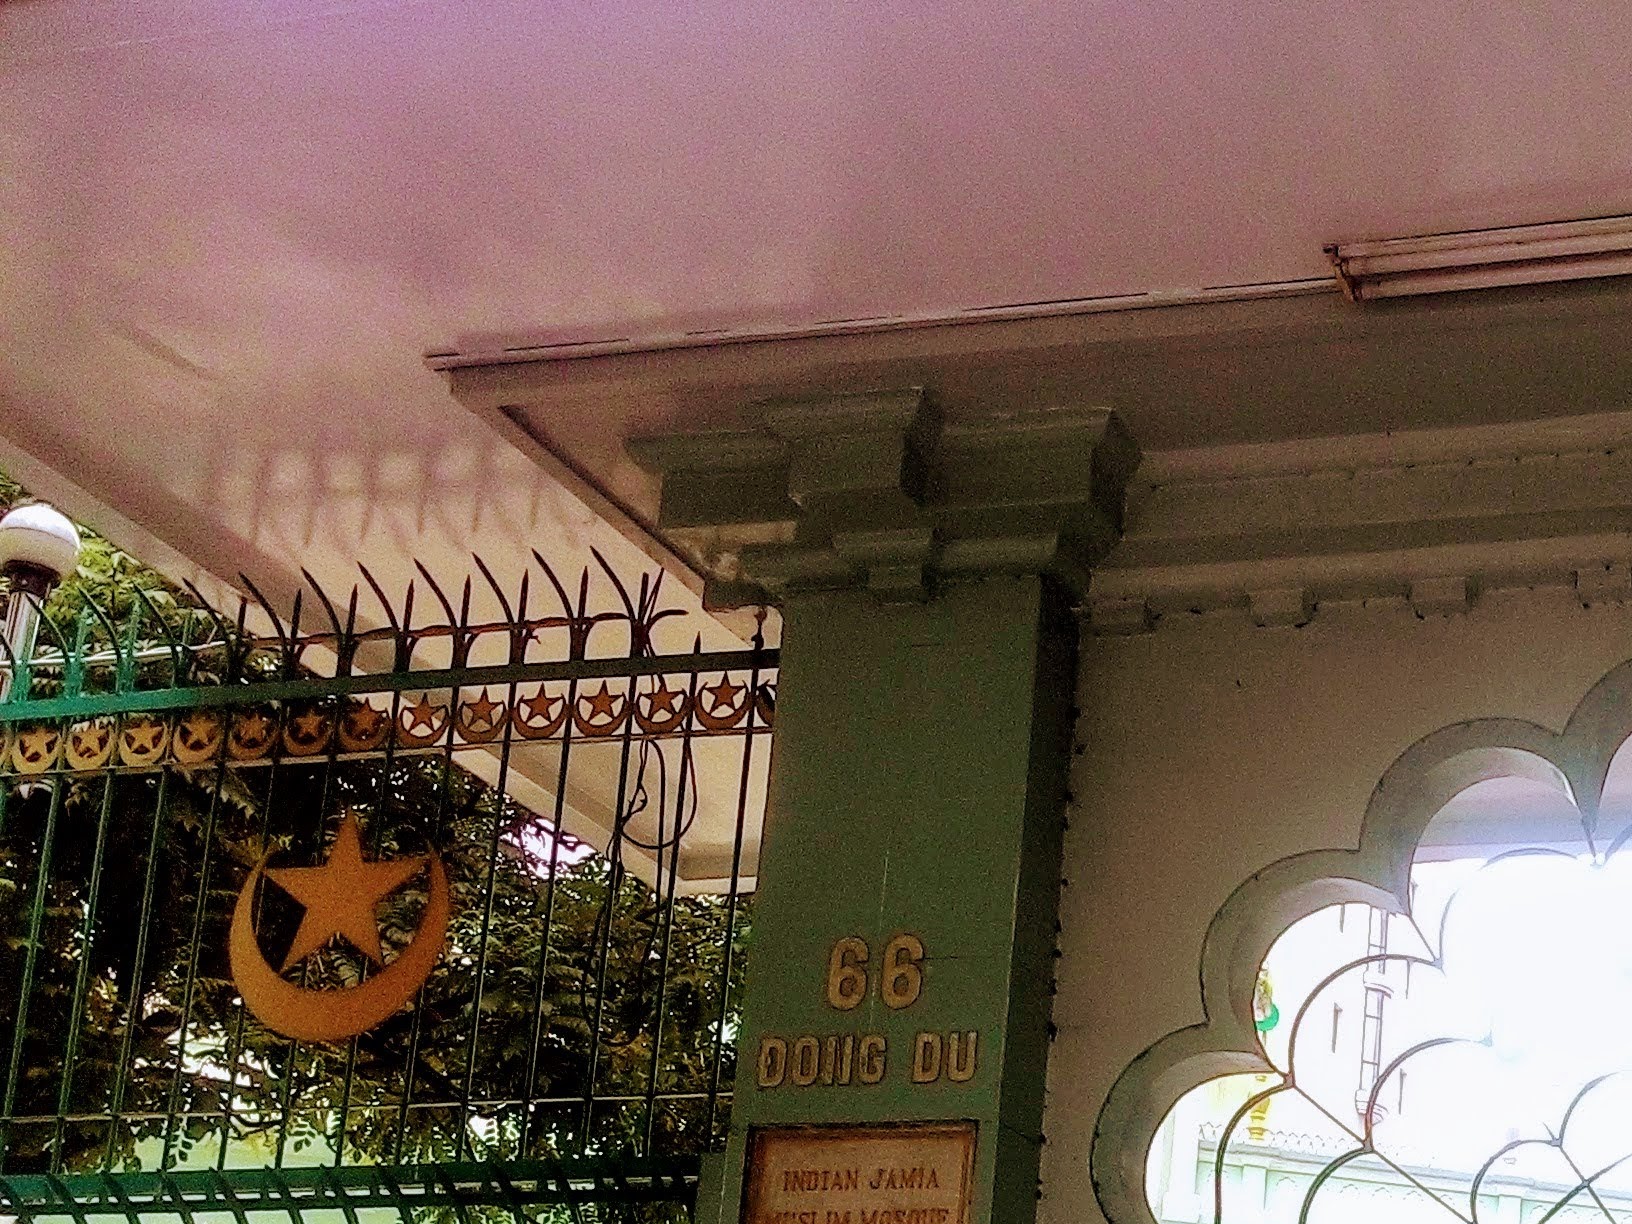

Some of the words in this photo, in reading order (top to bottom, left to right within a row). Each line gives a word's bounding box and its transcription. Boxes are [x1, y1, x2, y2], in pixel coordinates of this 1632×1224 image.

[827, 932, 924, 1011] 66
[912, 1030, 978, 1083] DU
[783, 1168, 859, 1191] INDIAN
[870, 1167, 939, 1190] JAMIA
